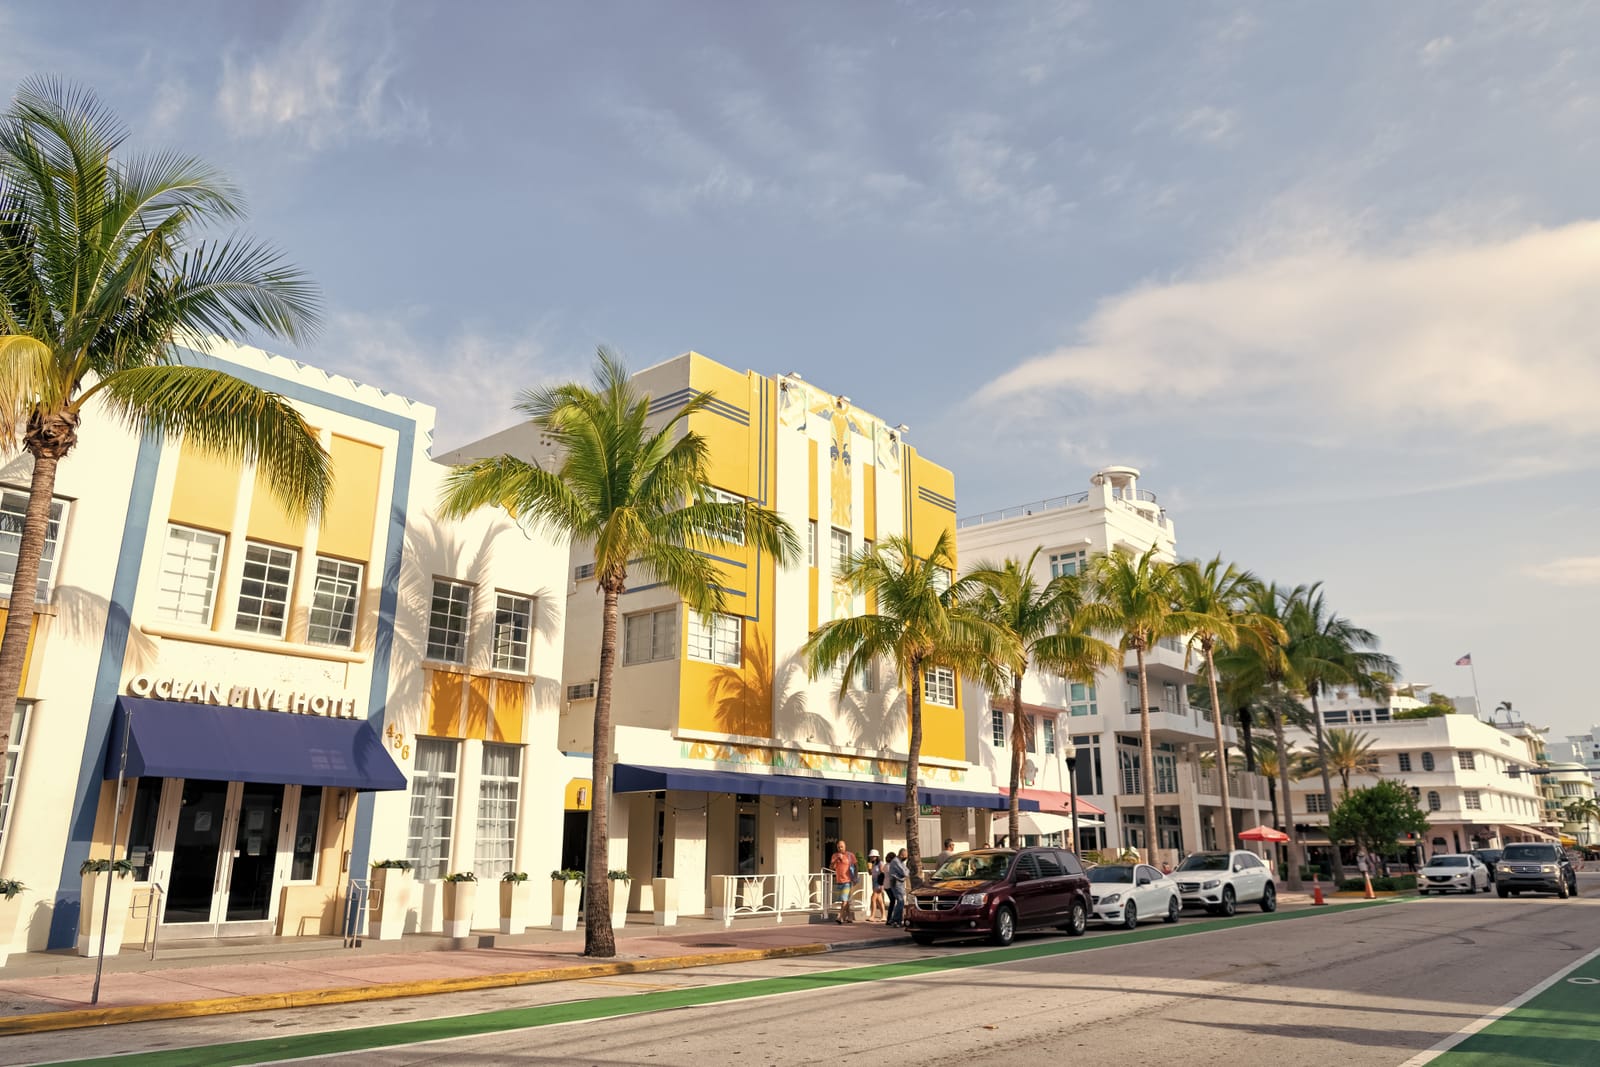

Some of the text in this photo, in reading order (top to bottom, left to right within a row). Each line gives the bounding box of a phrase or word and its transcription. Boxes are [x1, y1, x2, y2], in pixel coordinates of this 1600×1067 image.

[129, 675, 358, 718] OCEAN FIVE HOTEL
[386, 721, 410, 760] 436
